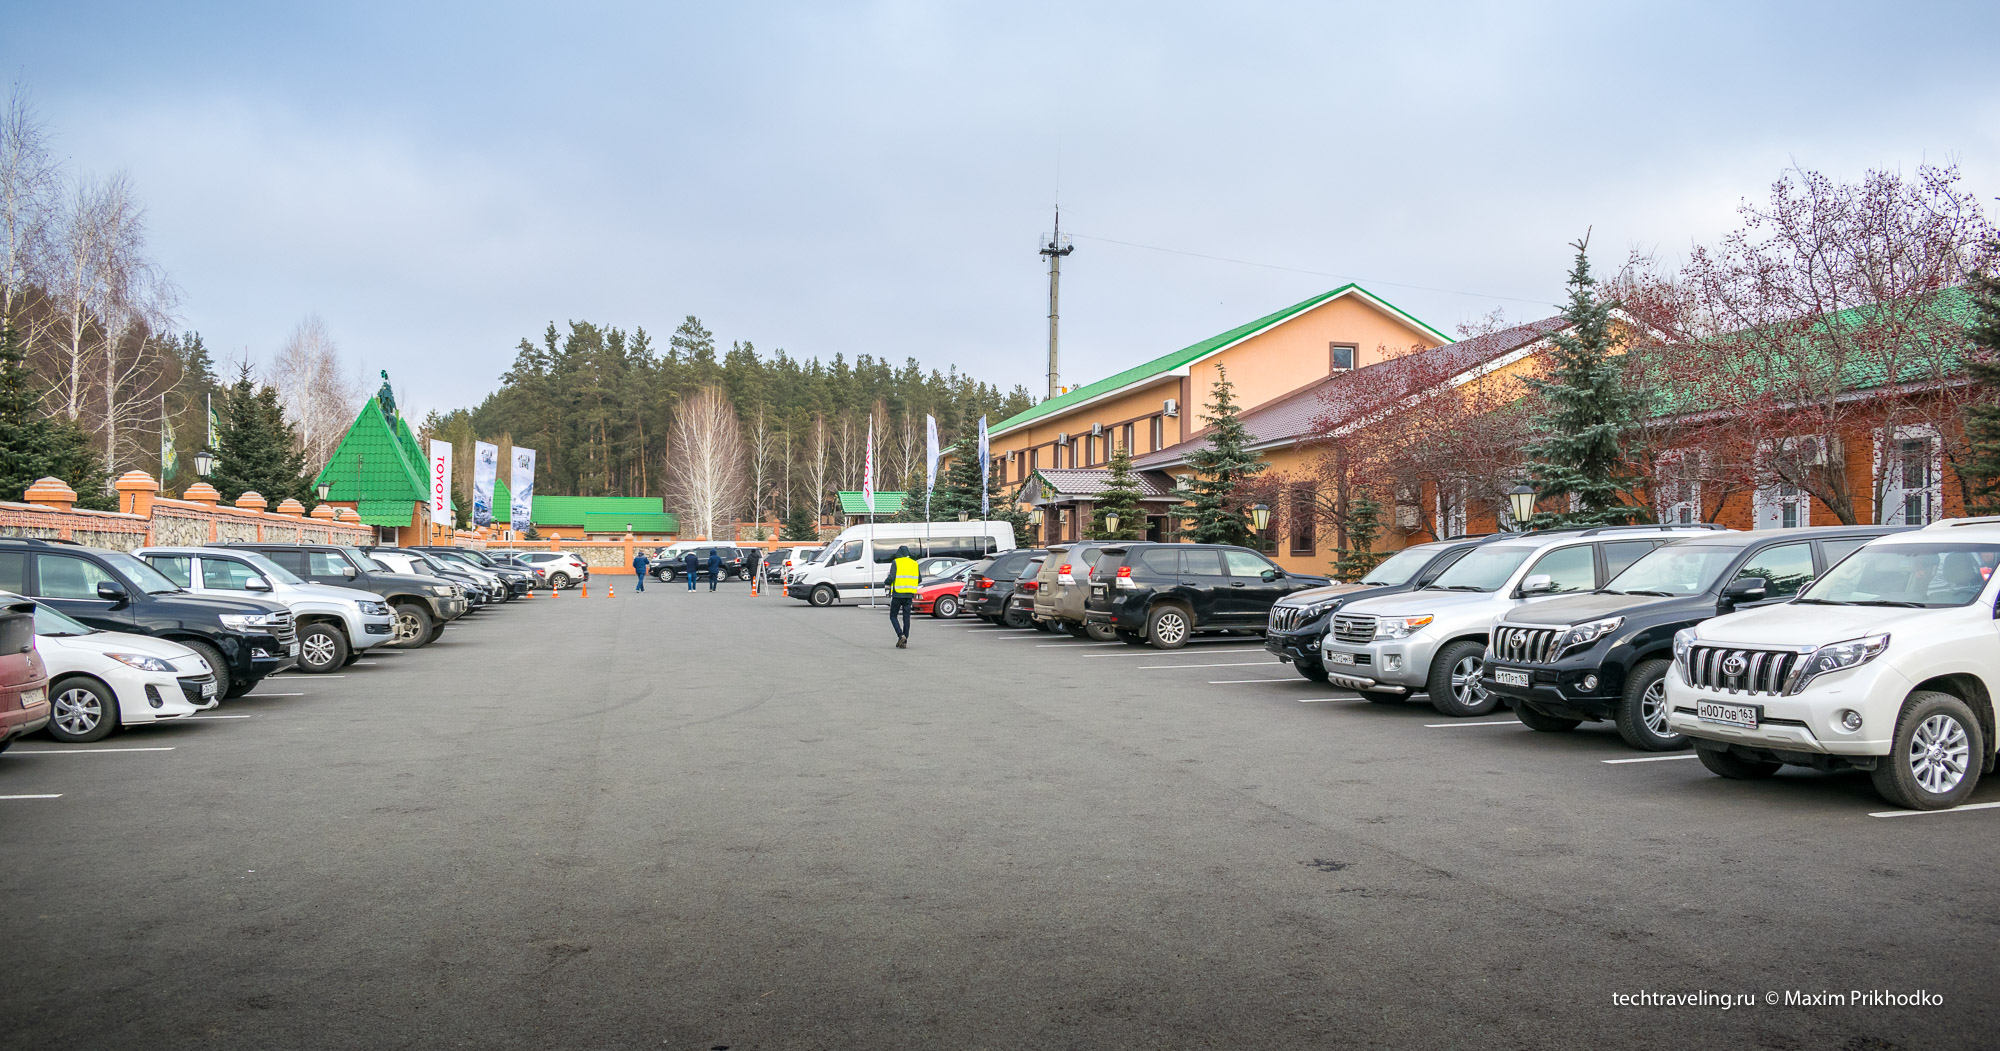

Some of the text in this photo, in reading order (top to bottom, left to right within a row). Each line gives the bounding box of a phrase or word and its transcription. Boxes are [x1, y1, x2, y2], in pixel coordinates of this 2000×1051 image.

[435, 456, 445, 511] TOYOTA
[1700, 704, 1753, 720] Н007ОВ 163
